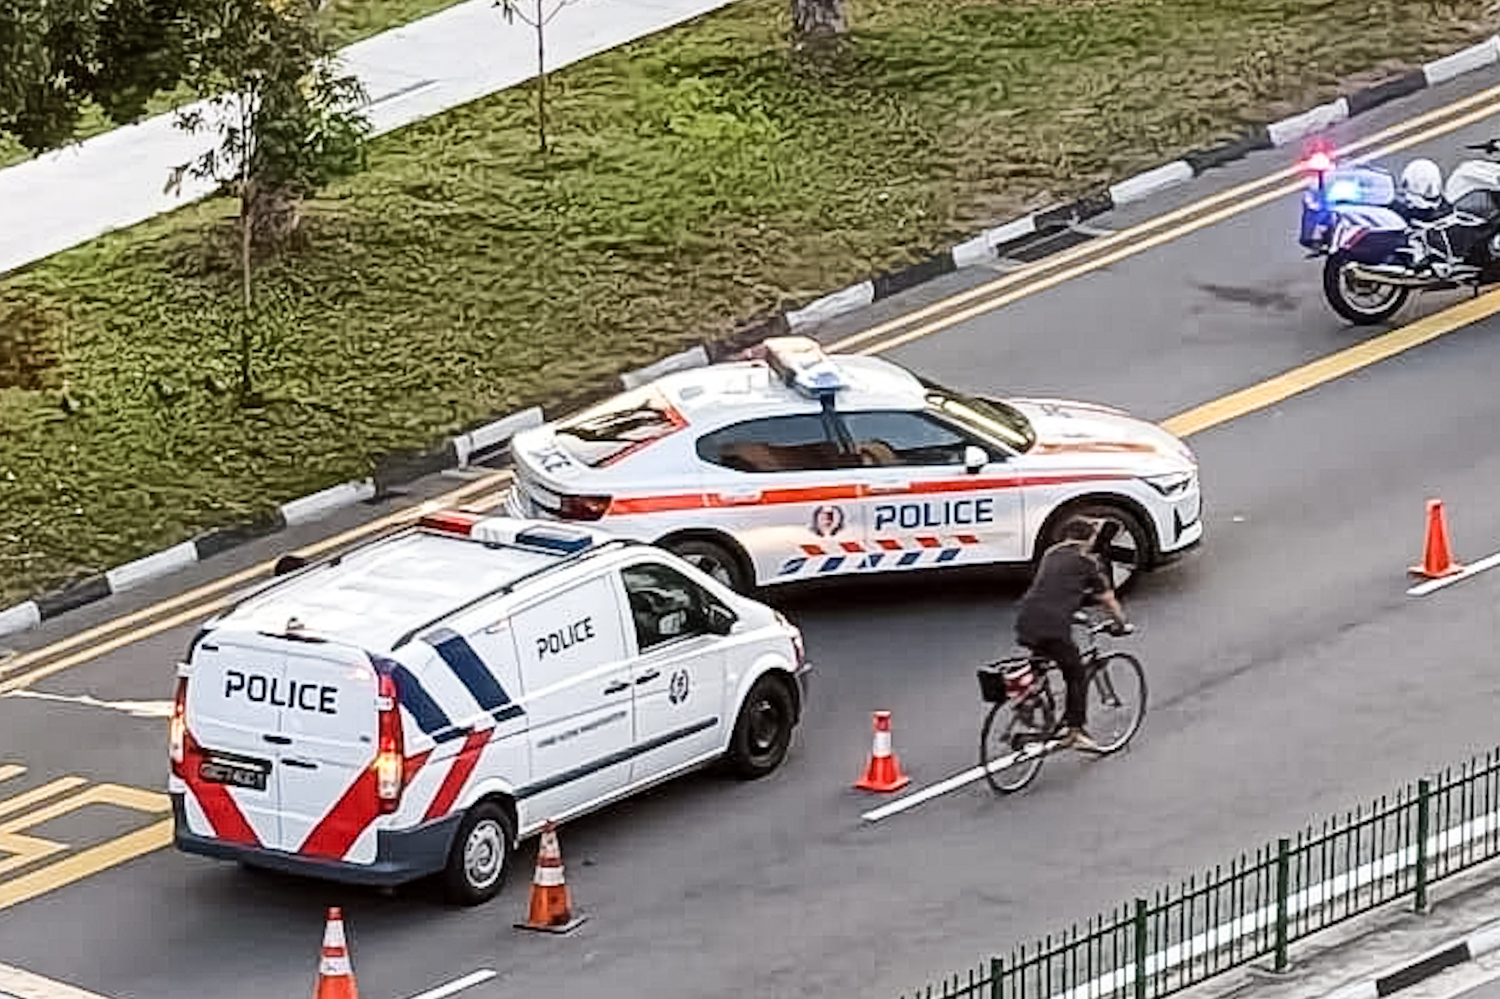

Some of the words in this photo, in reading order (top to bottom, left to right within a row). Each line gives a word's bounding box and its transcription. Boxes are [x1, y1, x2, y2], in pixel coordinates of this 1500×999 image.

[876, 499, 993, 530] POLICE
[537, 616, 595, 661] POLICE
[225, 670, 338, 714] POLICE
